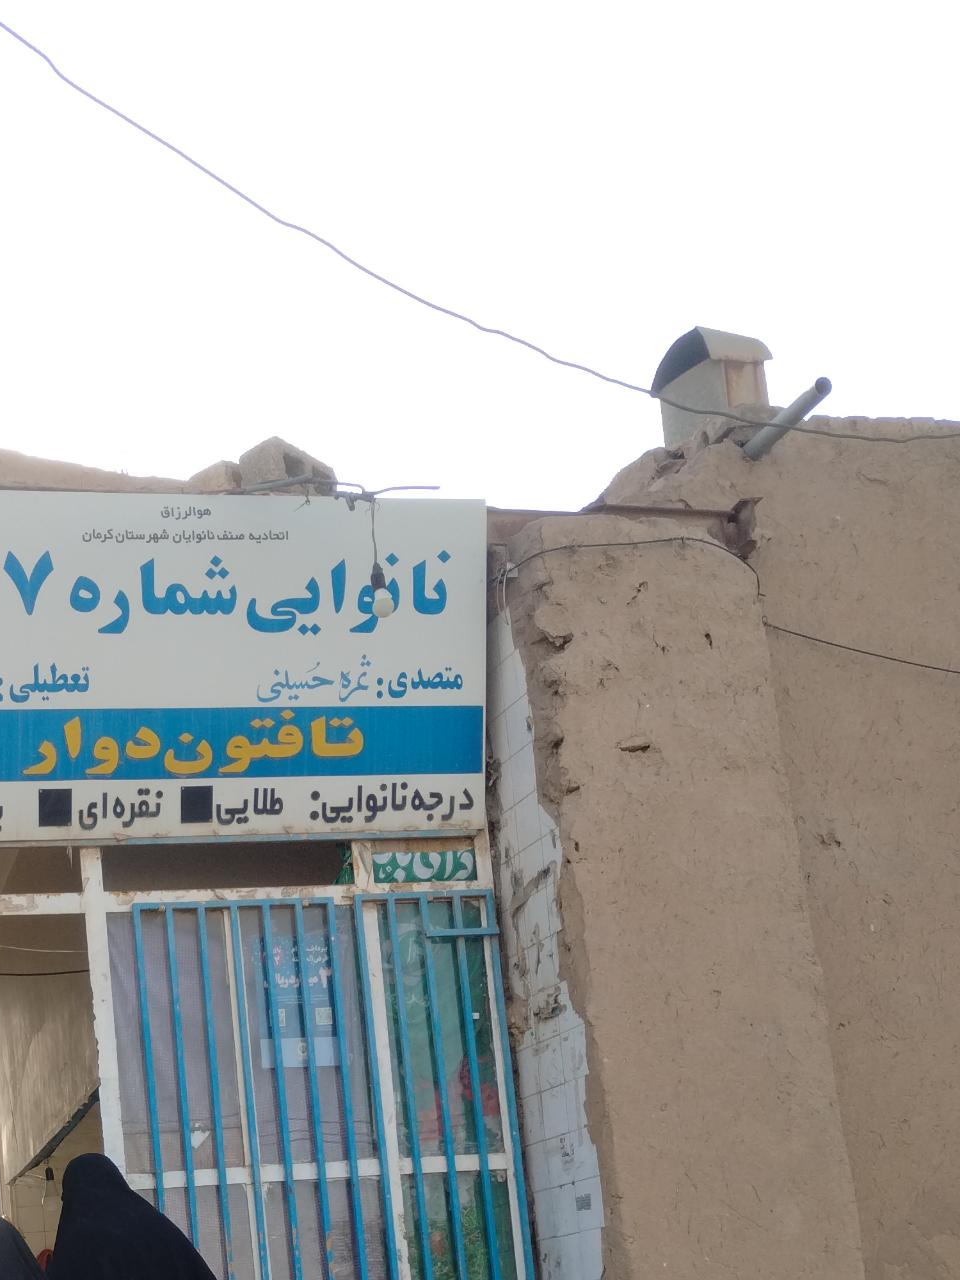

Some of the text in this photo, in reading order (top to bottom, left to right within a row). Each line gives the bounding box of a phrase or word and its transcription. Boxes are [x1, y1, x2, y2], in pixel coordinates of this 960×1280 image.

[82, 528, 289, 544] اتحادیه صنف نانوایان شهرستان کرمان
[69, 556, 239, 634] شماره
[246, 550, 451, 634] نانوایی
[376, 667, 463, 700] متصدی:
[24, 710, 363, 775] تافتون دوار
[216, 788, 285, 827] طلایی
[309, 782, 409, 824] نانوایی:
[411, 788, 475, 822] درجه
